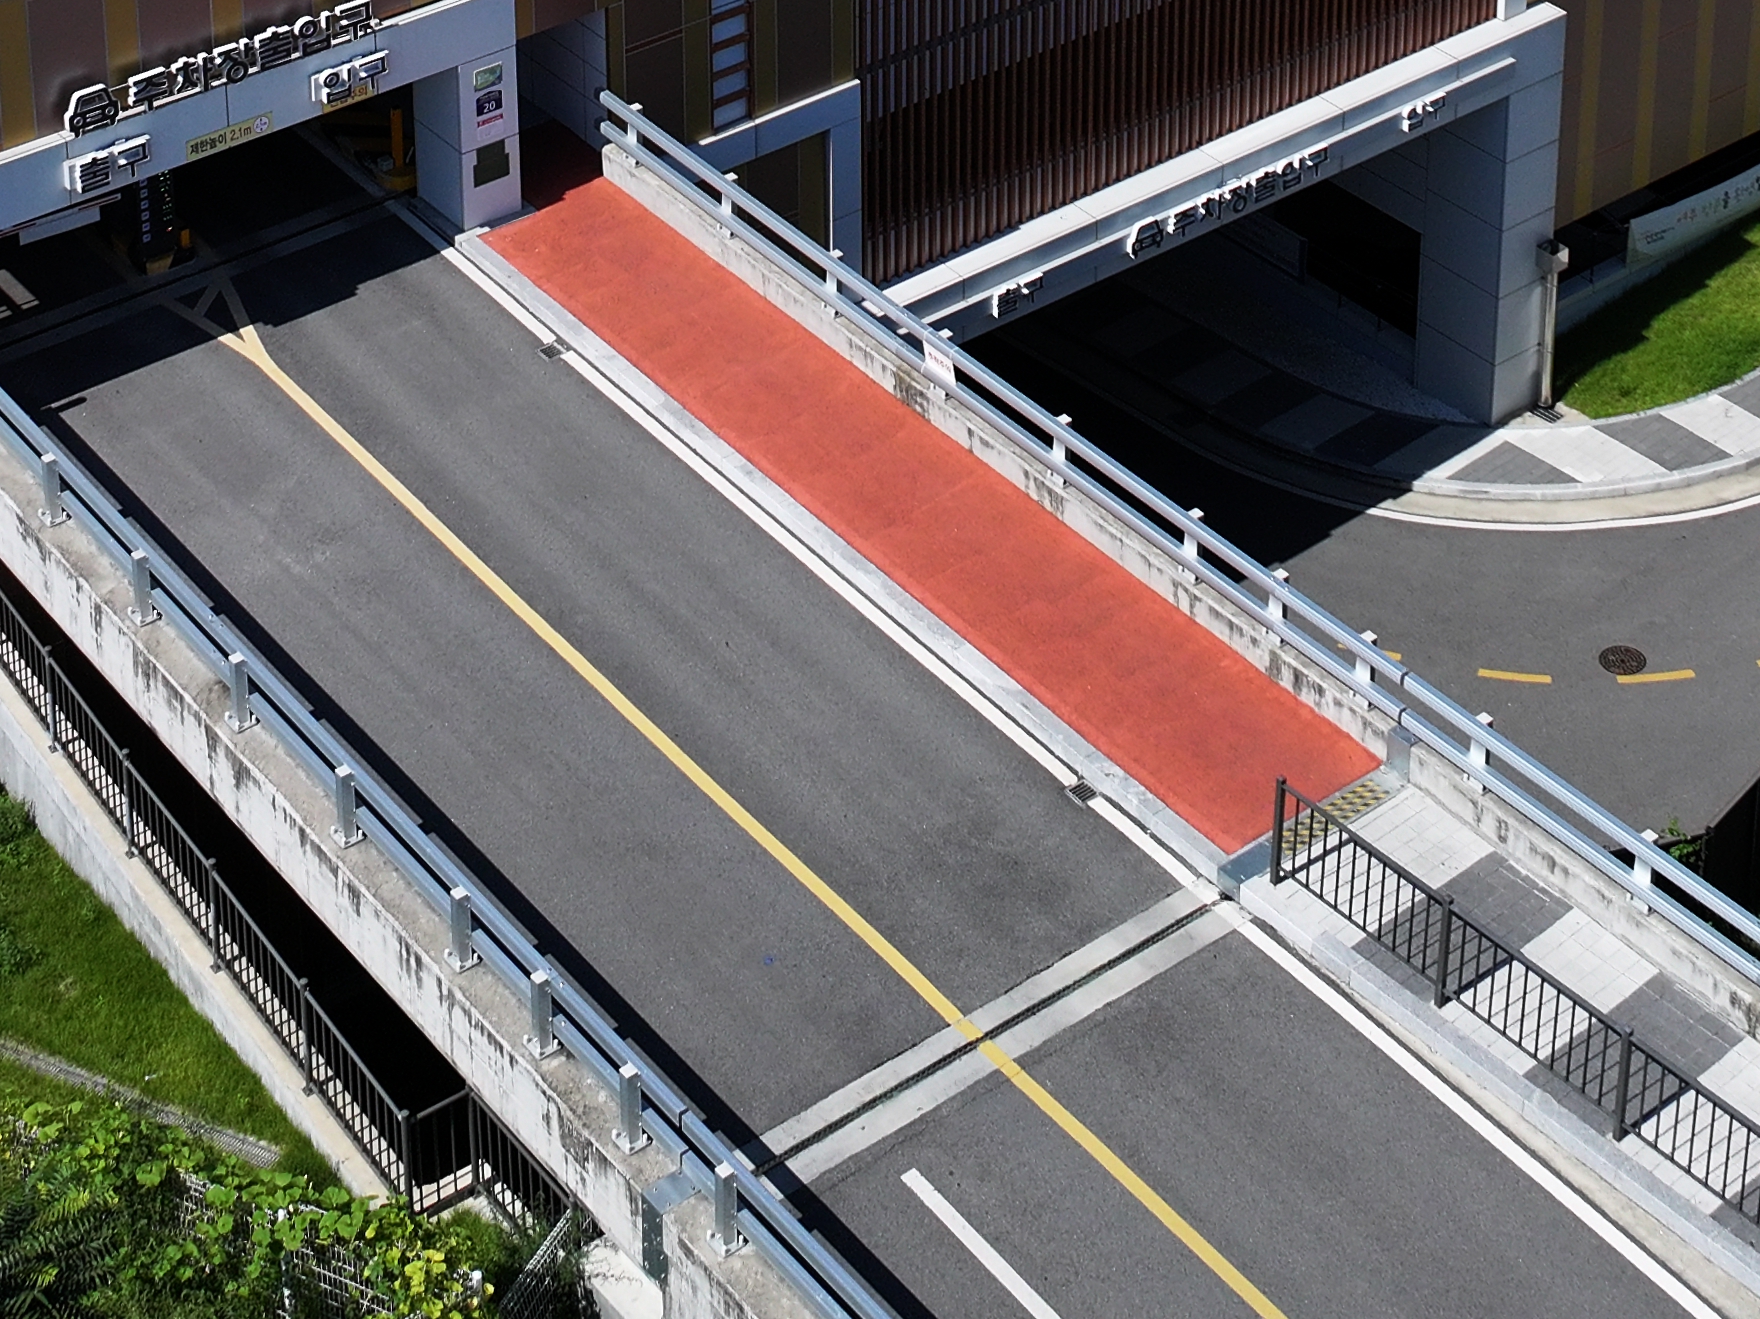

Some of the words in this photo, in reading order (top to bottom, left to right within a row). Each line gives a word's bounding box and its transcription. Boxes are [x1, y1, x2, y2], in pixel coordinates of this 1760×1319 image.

[322, 50, 389, 104] 입구
[483, 100, 496, 114] 20
[1400, 91, 1447, 133] 입구
[189, 132, 228, 156] 제한높이
[229, 123, 252, 141] 2.1m
[76, 134, 151, 194] 출구
[1167, 142, 1329, 238] 주차장출입구
